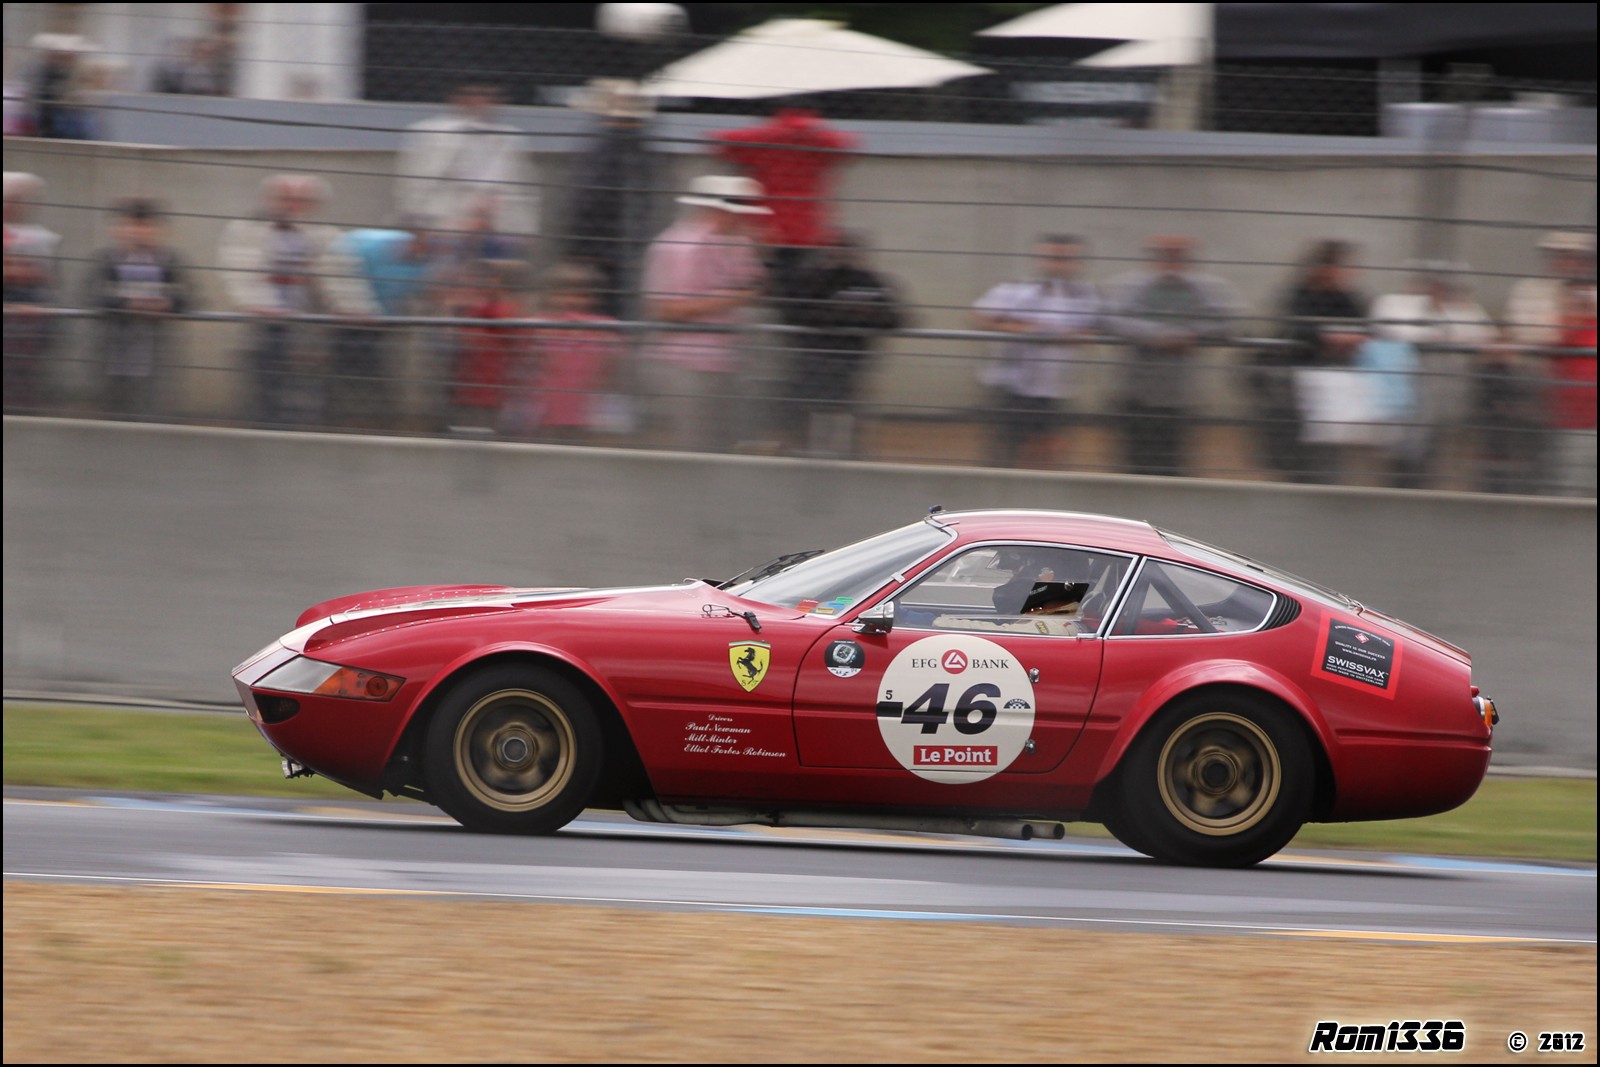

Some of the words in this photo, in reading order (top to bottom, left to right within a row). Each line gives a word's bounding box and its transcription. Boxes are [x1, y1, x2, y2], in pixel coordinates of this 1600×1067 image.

[912, 658, 937, 669] EFG
[972, 658, 1009, 669] BANK
[1327, 655, 1385, 679] SWISSVAX
[885, 690, 893, 700] 5
[901, 683, 1002, 735] 46
[708, 713, 733, 722] Drivers
[685, 721, 710, 731] Paul
[708, 723, 751, 734] Newman
[711, 745, 741, 755] Forbes
[742, 746, 787, 758] Robinson
[920, 748, 941, 763] Le
[943, 747, 992, 763] Point
